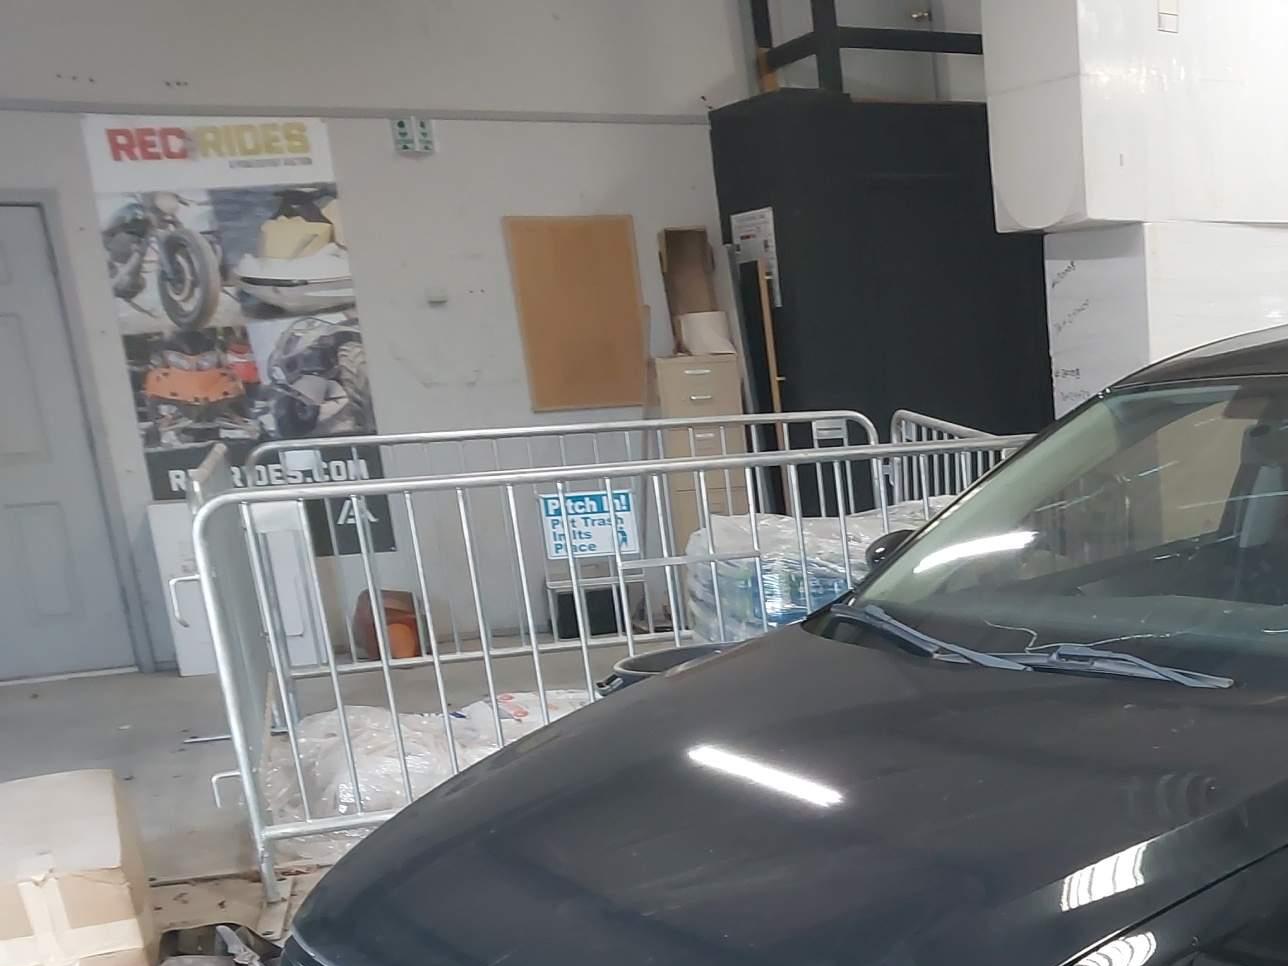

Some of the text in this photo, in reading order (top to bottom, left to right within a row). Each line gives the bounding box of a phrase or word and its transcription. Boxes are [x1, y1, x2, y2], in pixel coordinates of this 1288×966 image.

[547, 496, 598, 515] Ptch
[551, 517, 577, 530] Pt
[554, 542, 597, 554] Pace
